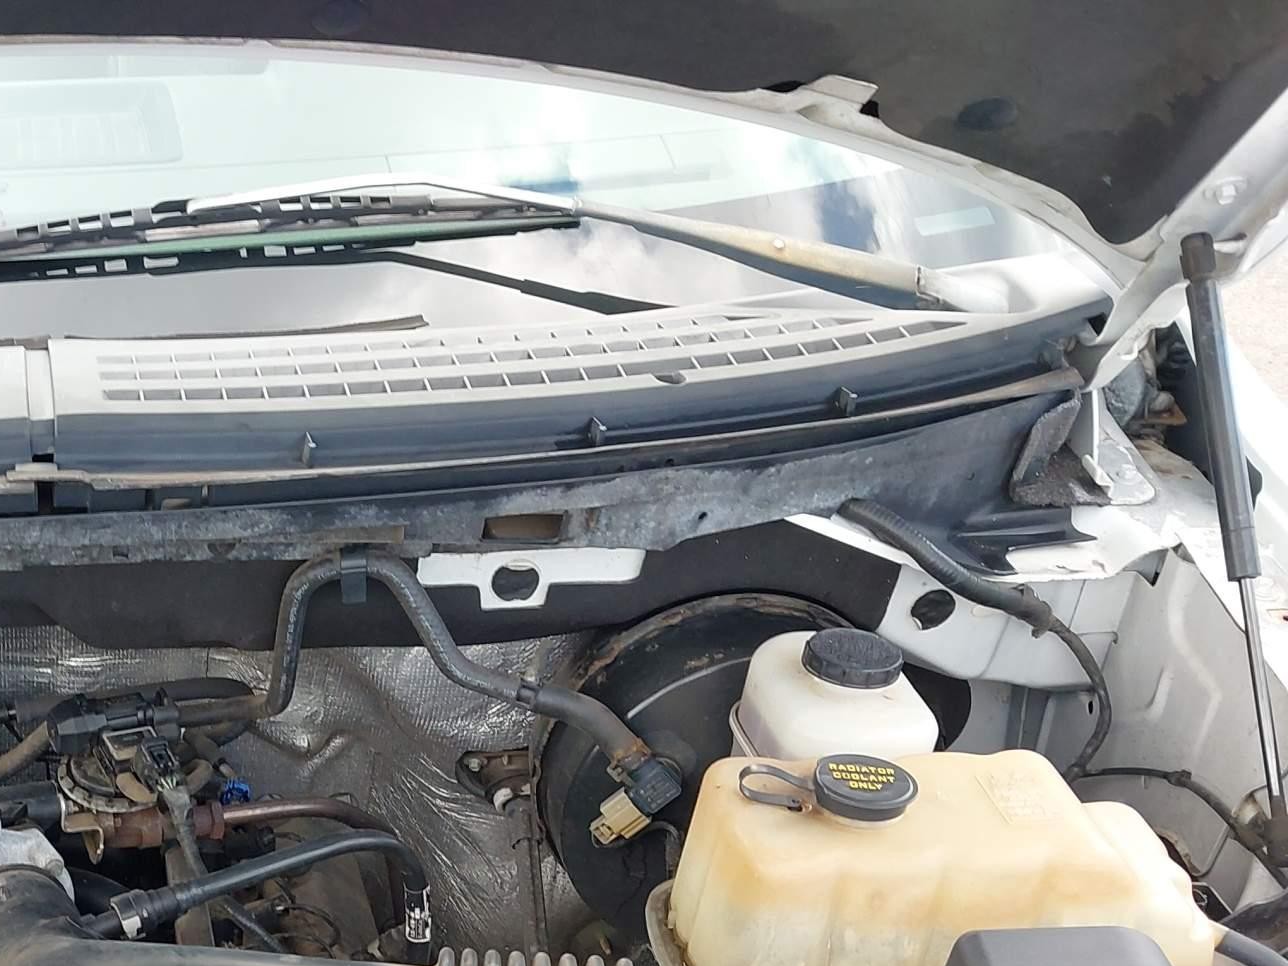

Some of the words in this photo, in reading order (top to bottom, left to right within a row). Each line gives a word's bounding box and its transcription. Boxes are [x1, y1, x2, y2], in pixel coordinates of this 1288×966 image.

[828, 763, 895, 775] RADIATOR
[832, 771, 895, 783] COOLANT
[849, 781, 883, 790] ONLY
